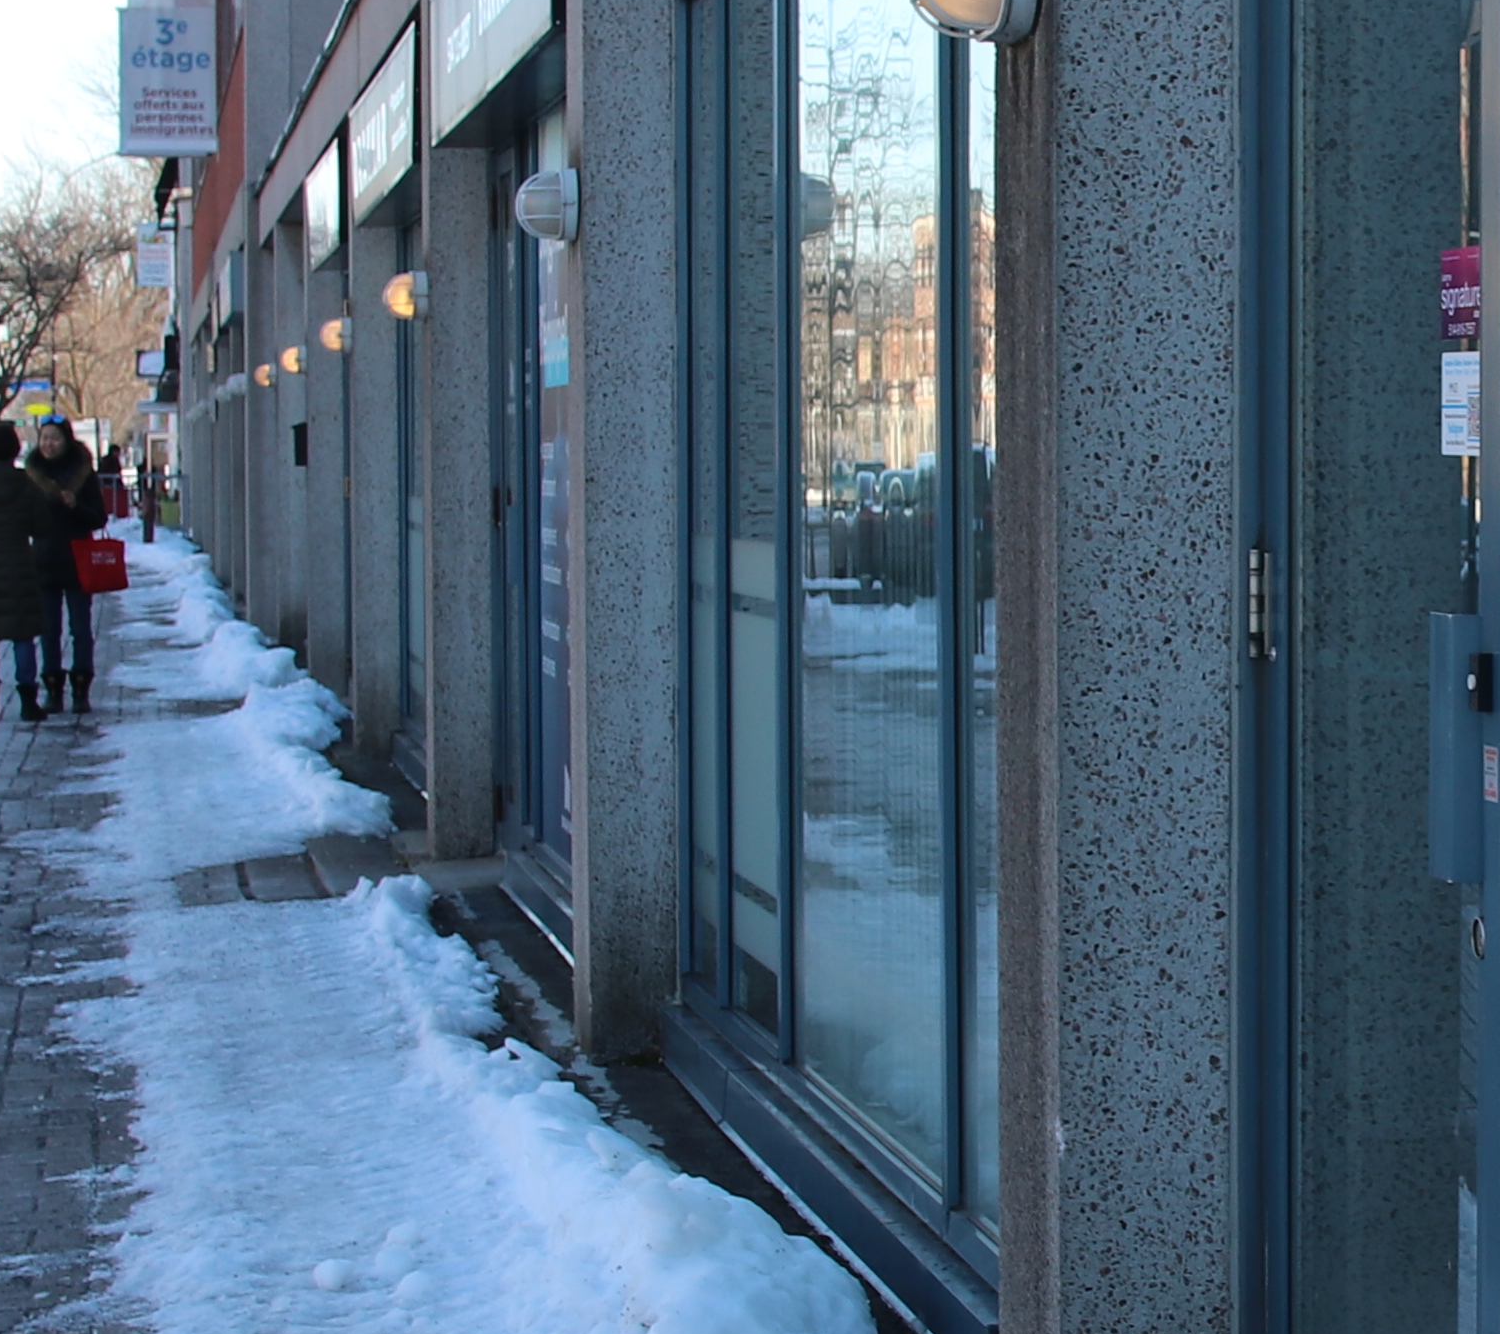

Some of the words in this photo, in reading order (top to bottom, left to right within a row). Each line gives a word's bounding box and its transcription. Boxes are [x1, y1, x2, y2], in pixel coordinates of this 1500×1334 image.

[131, 45, 211, 73] étage
[142, 86, 197, 98] Services
[134, 99, 177, 110] offerts
[182, 101, 204, 110] aux
[135, 112, 203, 124] personnes
[130, 123, 214, 137] immigrantes
